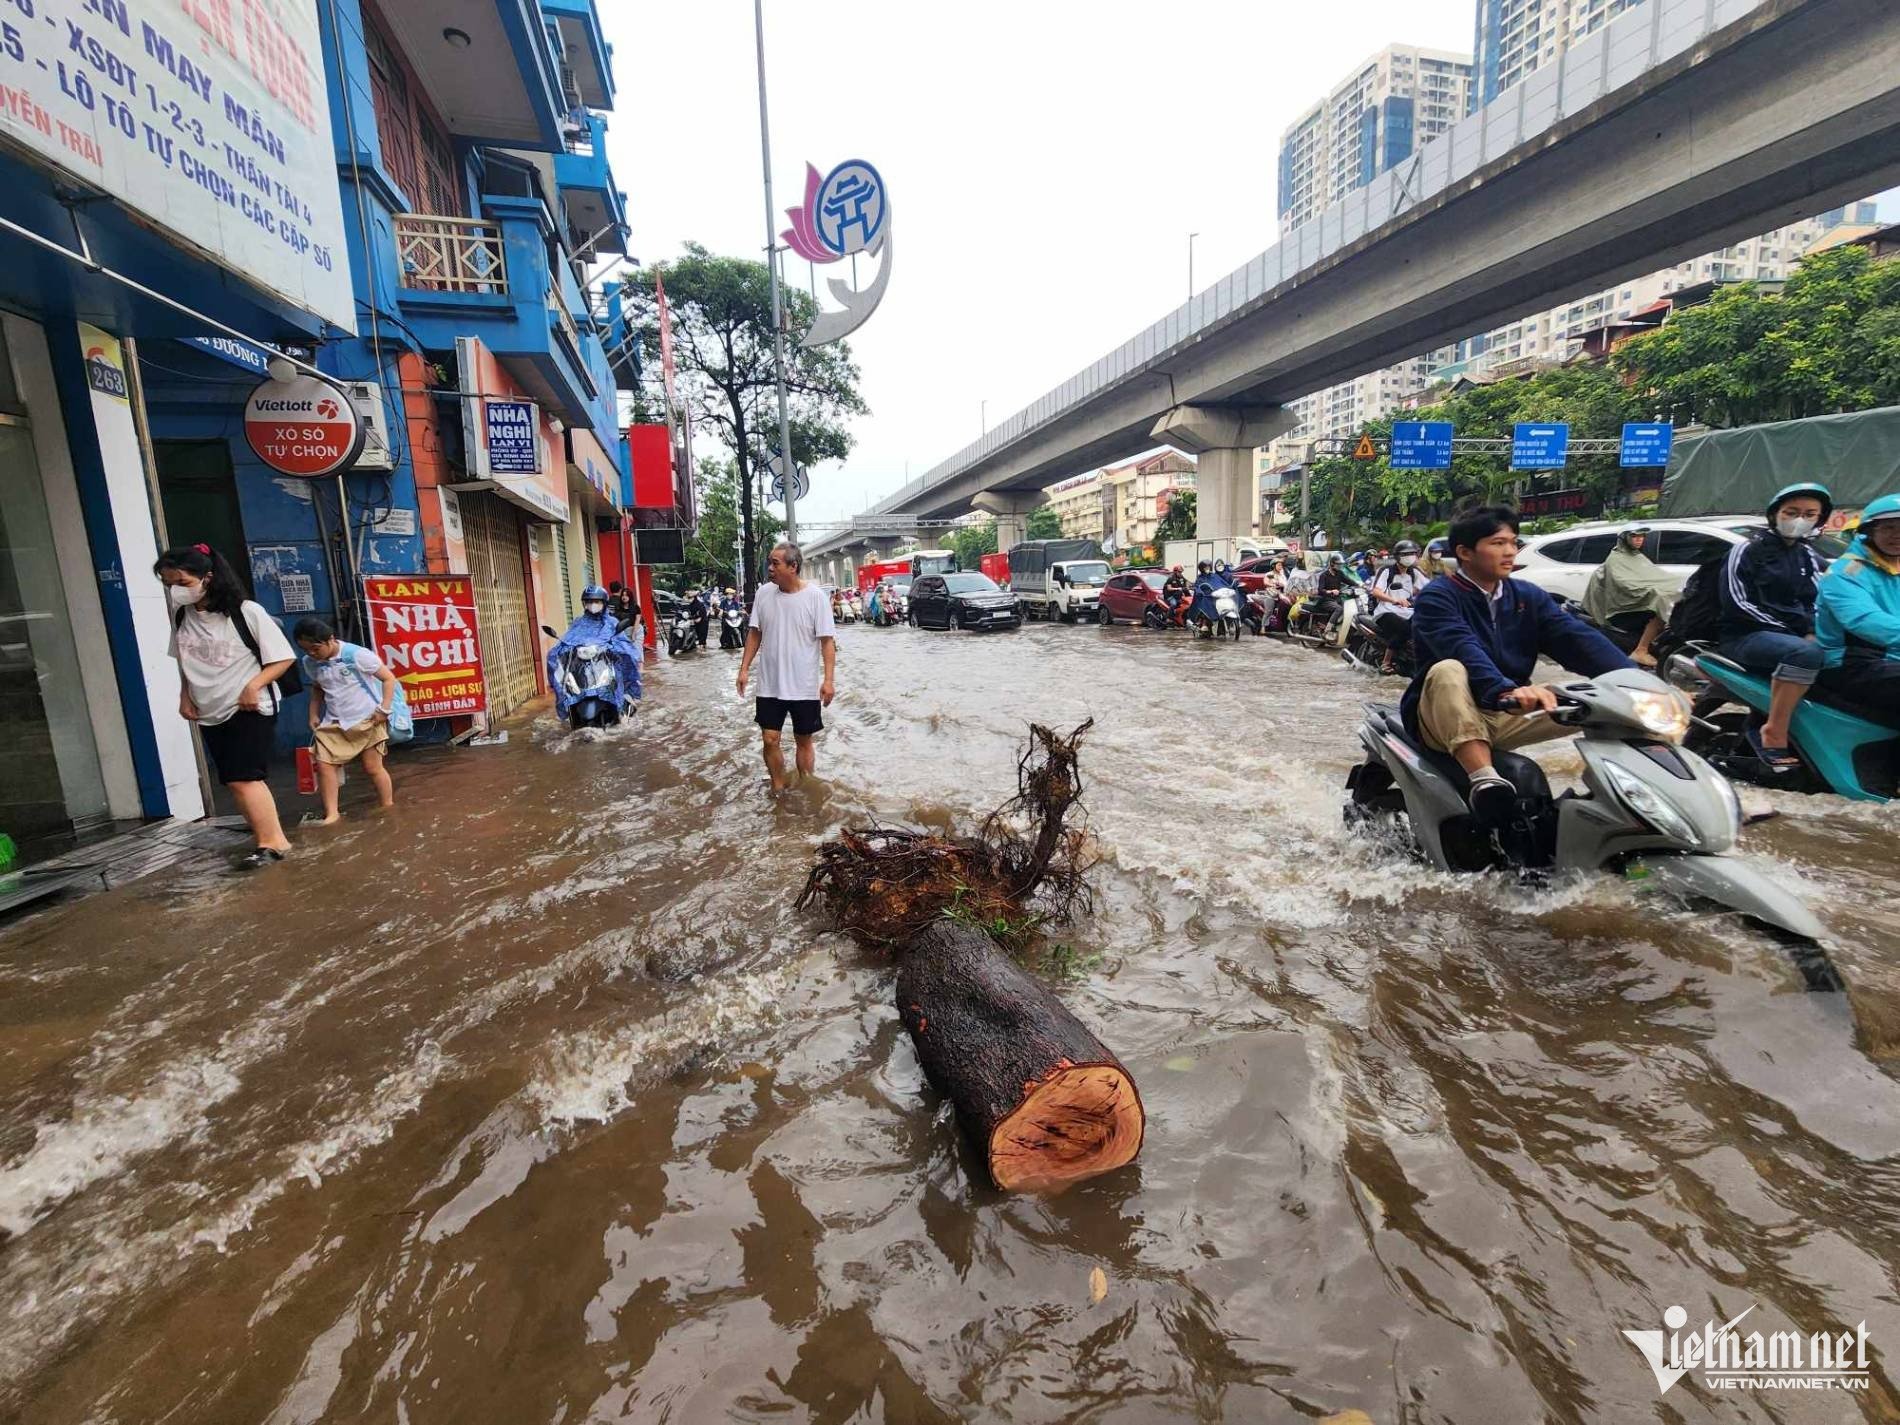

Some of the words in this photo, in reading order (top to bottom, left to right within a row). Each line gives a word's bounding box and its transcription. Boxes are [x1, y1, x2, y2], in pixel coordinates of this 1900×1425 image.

[141, 19, 212, 104] MAY
[223, 91, 286, 165] MẮN
[145, 83, 205, 147] 1-2-3
[303, 203, 313, 226] 4
[57, 59, 95, 111] LÔ
[101, 91, 136, 139] TÔ
[142, 121, 173, 169] TỰ
[179, 149, 236, 208] CHỌN
[241, 192, 275, 234] CÁC
[279, 220, 309, 255] CẶP
[313, 243, 332, 272] SỐ
[93, 366, 123, 393] 263
[256, 399, 313, 411] Vietlott
[489, 407, 529, 422] NHÀ
[489, 422, 531, 438] NGHỈ
[492, 439, 515, 447] LAN
[291, 444, 338, 460] CHỌN
[376, 582, 431, 597] LAN
[436, 581, 465, 594] VI
[382, 597, 468, 633] NHÀ
[382, 628, 479, 670] NGHỈ
[442, 683, 467, 698] LỊCH
